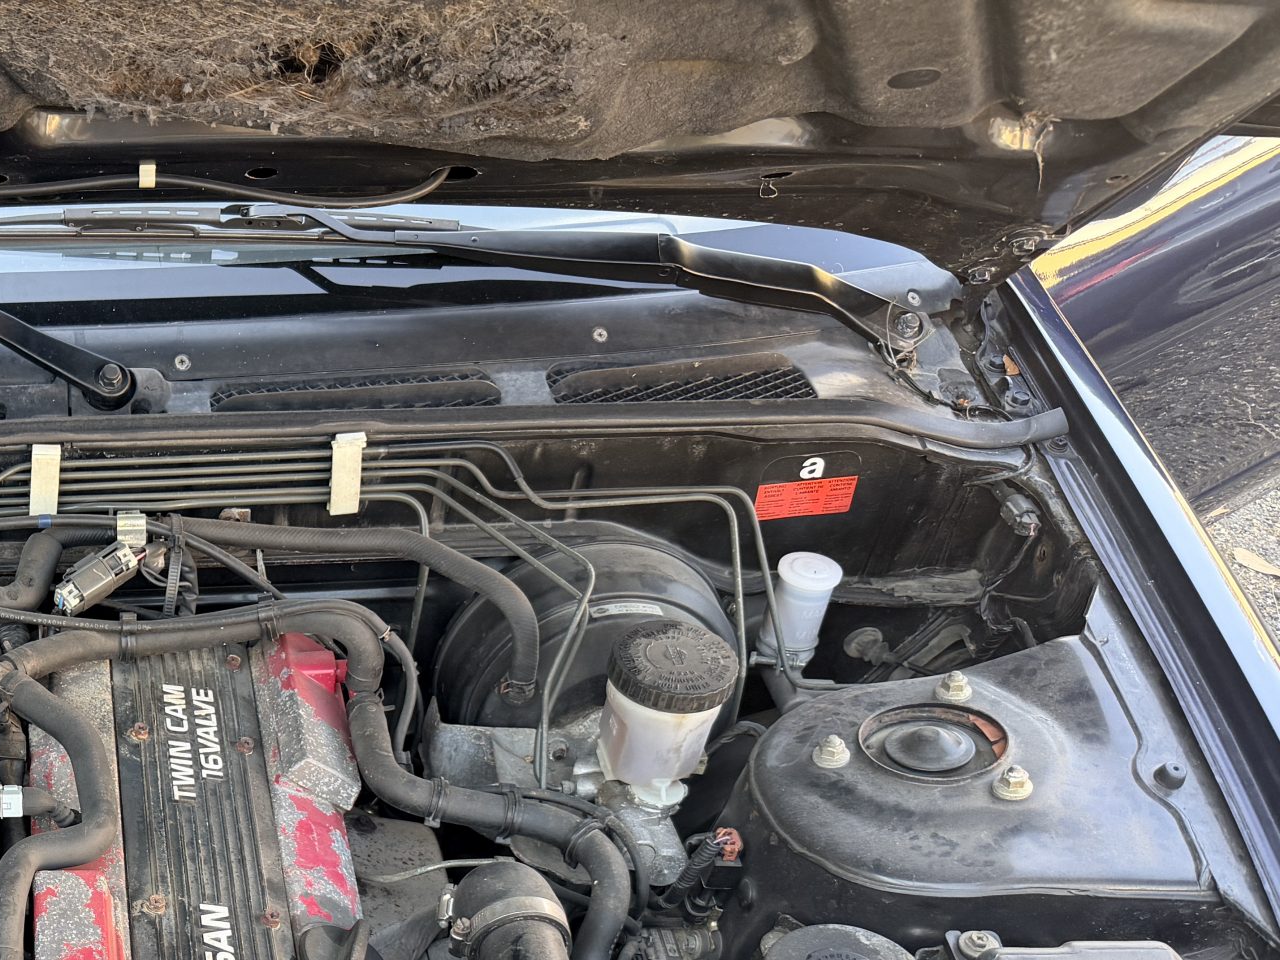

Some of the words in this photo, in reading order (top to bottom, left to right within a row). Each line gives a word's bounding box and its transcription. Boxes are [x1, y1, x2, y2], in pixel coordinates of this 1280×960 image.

[800, 457, 825, 479] a
[162, 684, 189, 733] CAM
[191, 687, 223, 778] 16VALVE
[168, 740, 197, 801] TWIN
